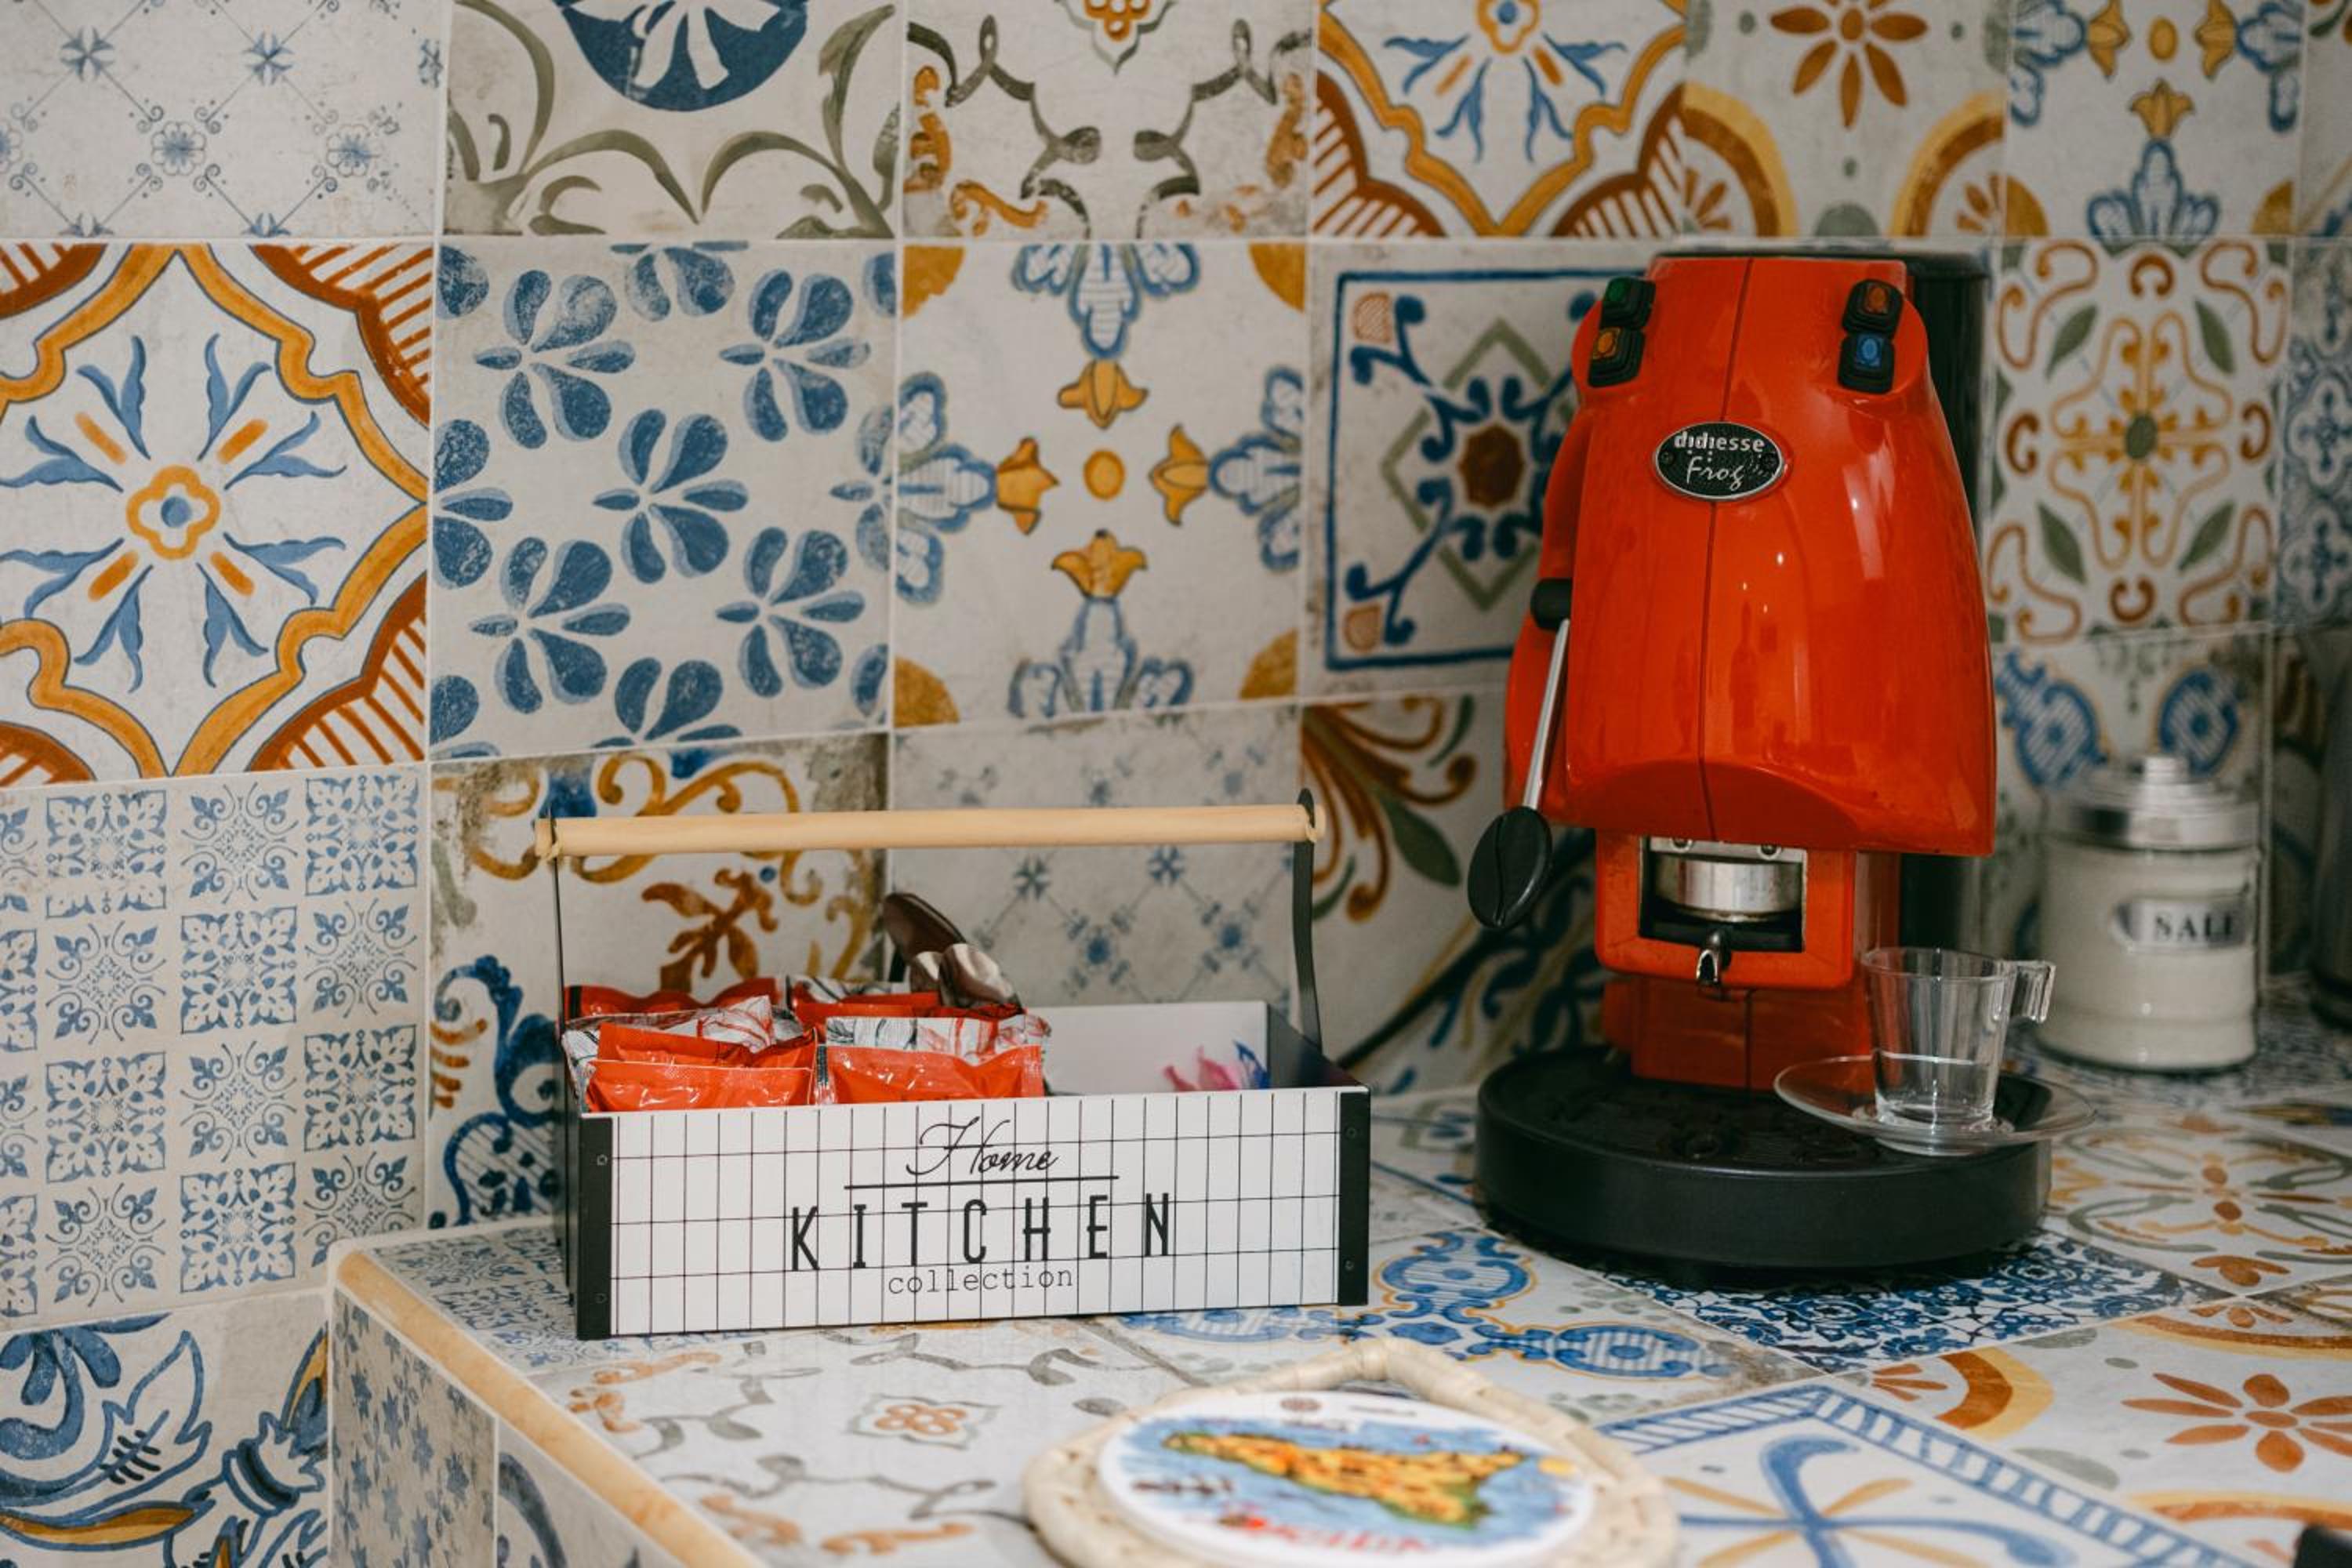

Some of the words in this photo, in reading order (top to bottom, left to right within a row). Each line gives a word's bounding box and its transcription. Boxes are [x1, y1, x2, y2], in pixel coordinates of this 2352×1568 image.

[1674, 431, 1765, 454] didiesse
[906, 1116, 1059, 1176] Home
[792, 1193, 1169, 1271] KITCHEN
[888, 1265, 1074, 1294] collection
